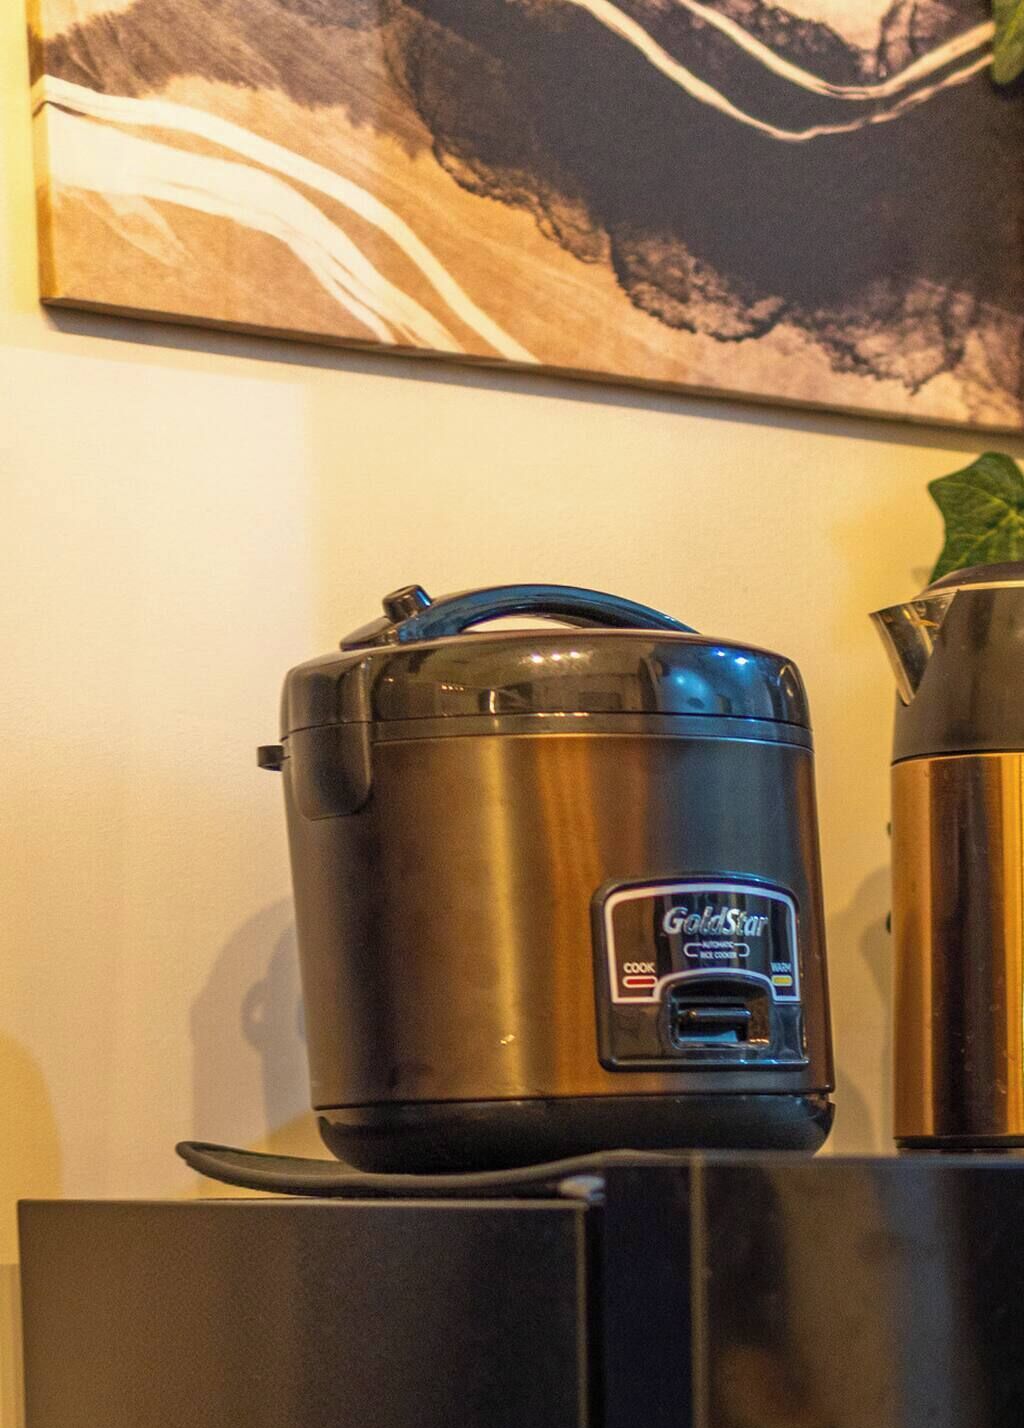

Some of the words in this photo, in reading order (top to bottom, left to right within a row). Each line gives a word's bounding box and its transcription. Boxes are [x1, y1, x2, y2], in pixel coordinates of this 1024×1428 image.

[662, 906, 768, 937] GoldStar
[623, 963, 655, 973] COOK
[770, 962, 792, 972] WARM
